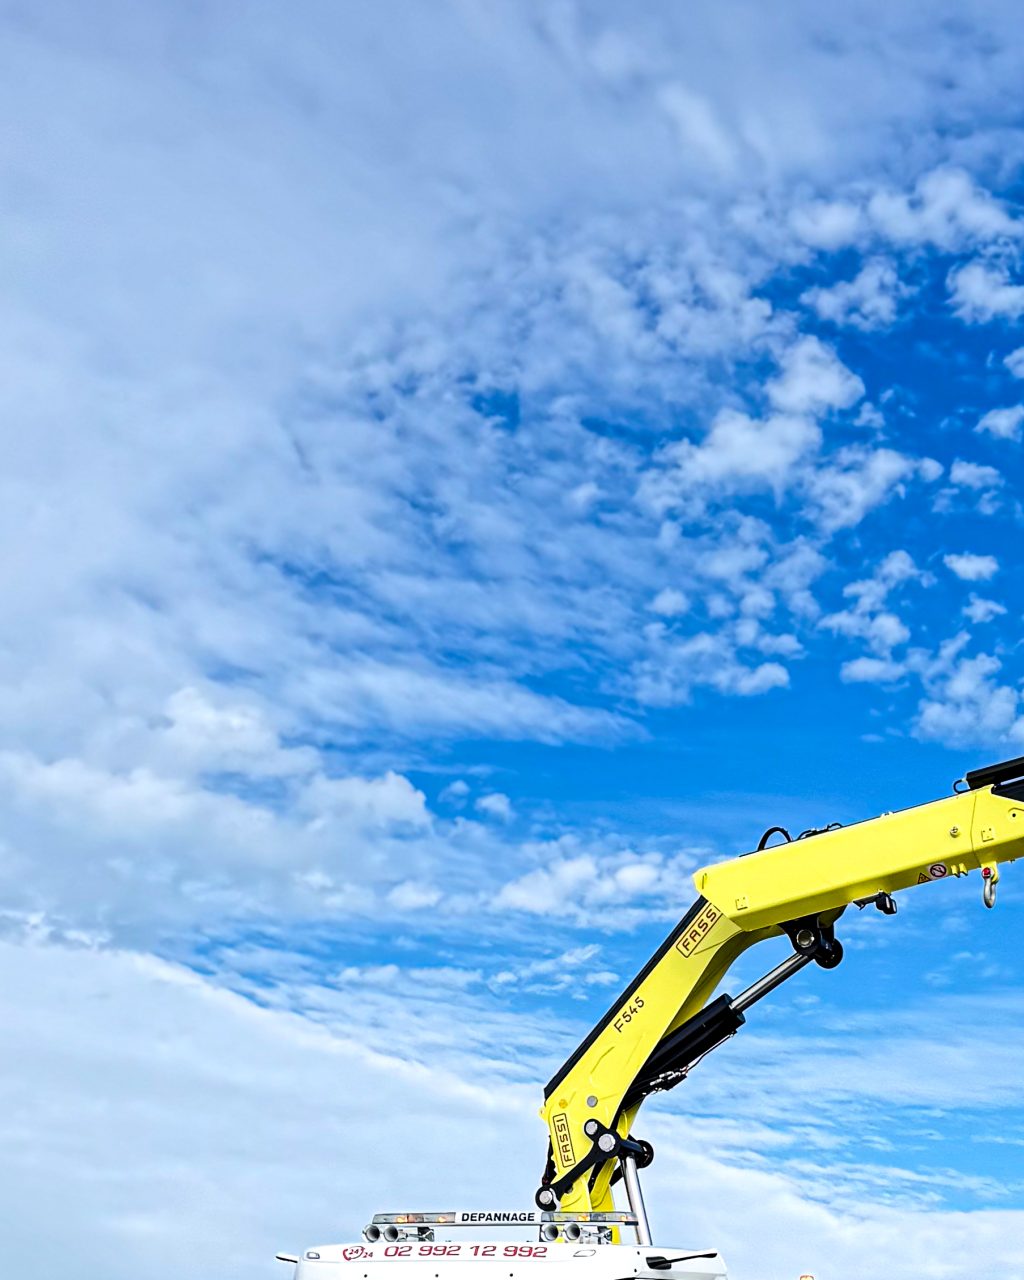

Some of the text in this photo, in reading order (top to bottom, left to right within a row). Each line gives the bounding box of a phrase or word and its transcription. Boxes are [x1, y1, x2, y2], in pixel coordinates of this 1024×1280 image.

[613, 996, 645, 1033] F545
[556, 1118, 573, 1163] FASSI
[461, 1212, 535, 1222] DEPANNAGE
[384, 1245, 548, 1257] 02 992 12 992
